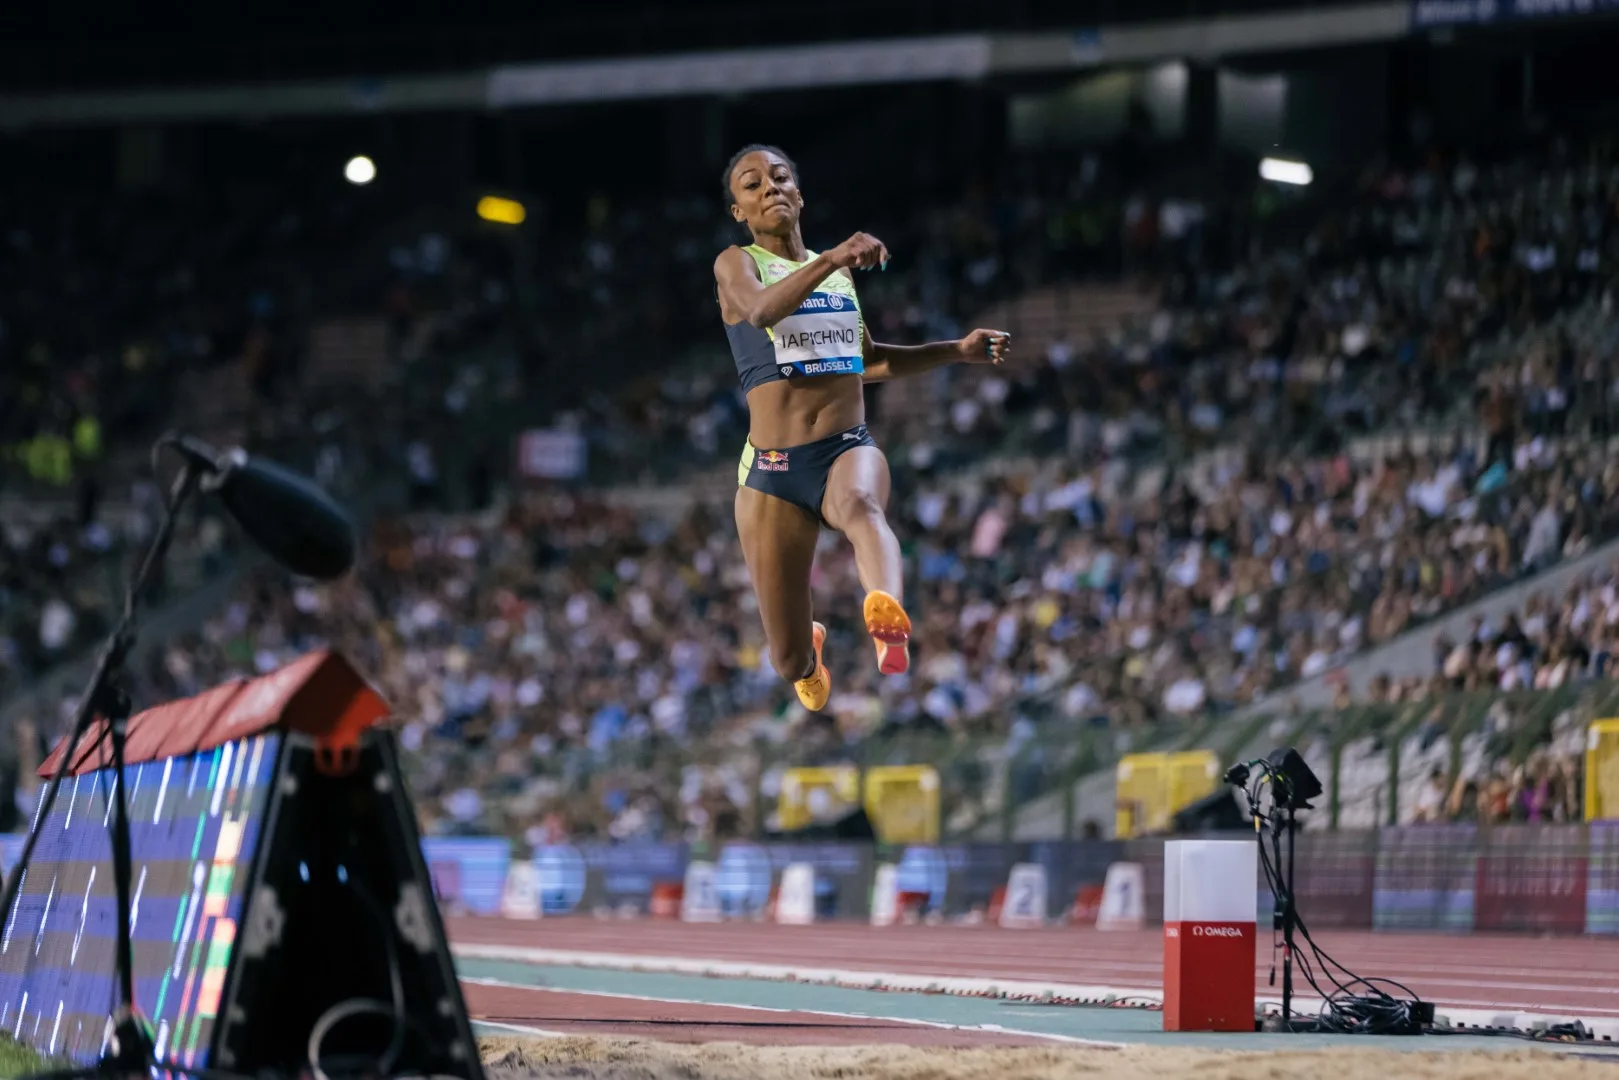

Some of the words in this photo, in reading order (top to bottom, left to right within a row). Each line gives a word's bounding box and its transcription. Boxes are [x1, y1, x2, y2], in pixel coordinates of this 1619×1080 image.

[781, 328, 854, 349] IAPICHINO
[804, 360, 853, 374] BRUSSELS
[757, 460, 773, 471] Red
[773, 462, 789, 472] Bull
[1015, 884, 1033, 915] 2
[1204, 926, 1243, 937] OMEGA
